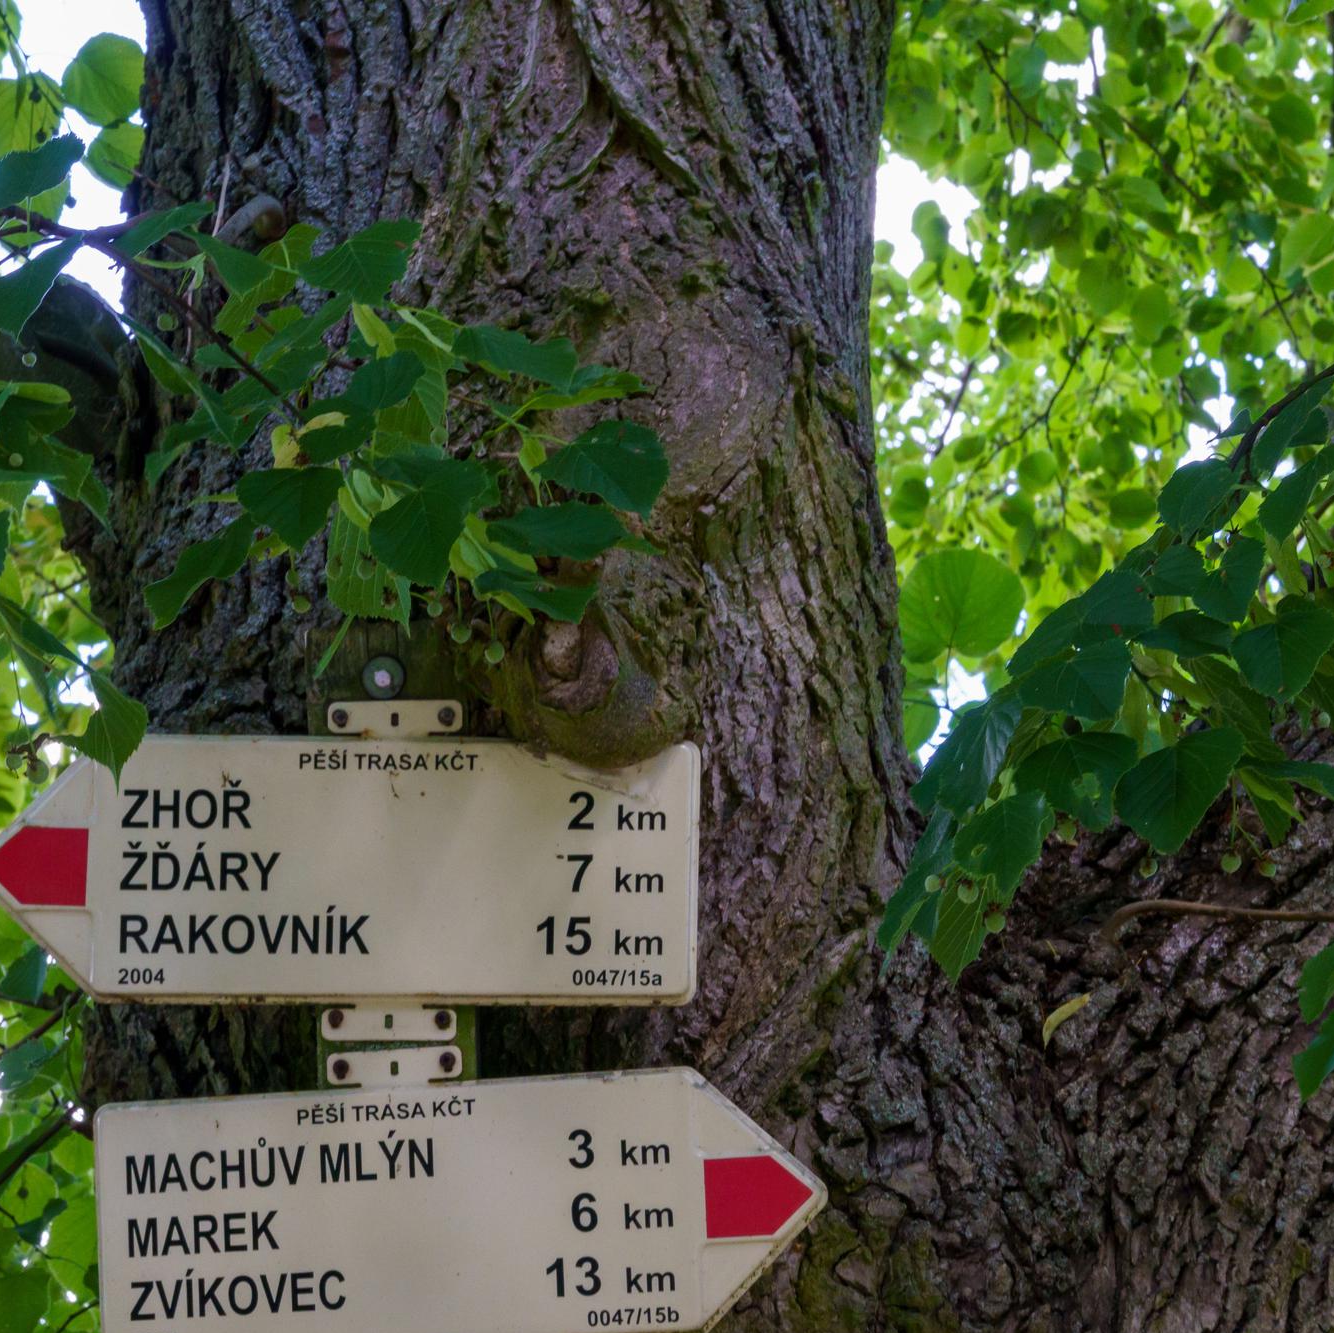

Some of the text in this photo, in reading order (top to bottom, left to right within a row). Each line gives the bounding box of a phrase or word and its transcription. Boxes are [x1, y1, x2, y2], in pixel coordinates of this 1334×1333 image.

[298, 746, 480, 772] PĚŠÍ TRASA KČT
[120, 780, 252, 830] ZHOŘ
[567, 789, 667, 831] 2 km
[119, 840, 282, 892] ŽĎÁRY
[566, 853, 664, 894] 7 km
[119, 904, 370, 955] RAKOVNÍK
[536, 915, 663, 957] 15 km
[117, 967, 166, 985] 2004
[572, 969, 662, 987] 0047/15a
[296, 1095, 476, 1126] PĚŠÍ TRASA KČT
[125, 1129, 435, 1196] MACHŮV MLÝN
[567, 1128, 671, 1170] 3 km
[570, 1192, 674, 1233] 6 km
[127, 1209, 280, 1259] MAREK
[129, 1267, 347, 1322] ZVÍKOVEC
[545, 1255, 676, 1298] 13 km
[587, 1306, 680, 1328] 0047/15b
